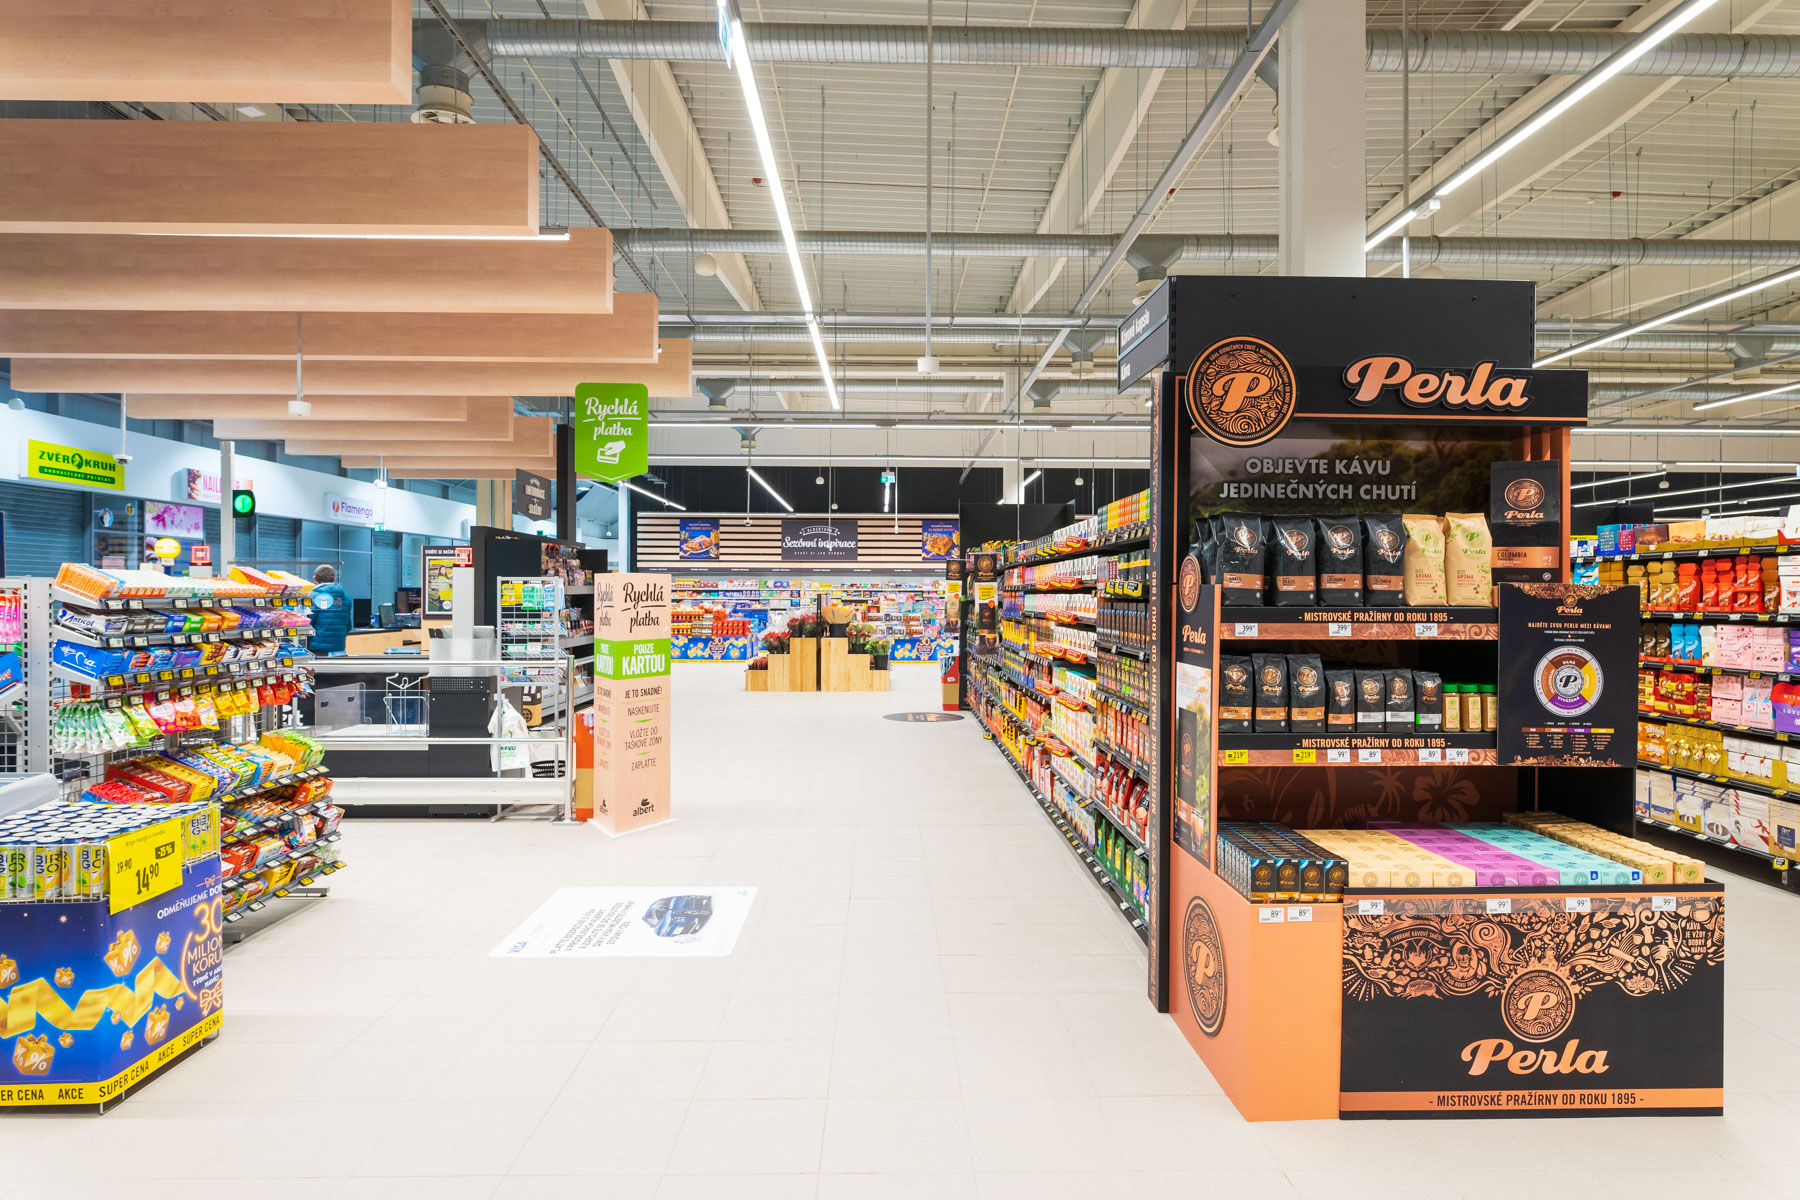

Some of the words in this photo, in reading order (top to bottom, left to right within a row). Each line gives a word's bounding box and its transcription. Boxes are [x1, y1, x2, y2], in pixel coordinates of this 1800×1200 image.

[1346, 356, 1529, 407] Perla
[1212, 372, 1271, 412] P
[585, 396, 639, 421] Rychlá
[593, 422, 632, 440] platba
[1245, 458, 1329, 474] OBJEVTE
[1335, 455, 1391, 475] KÁVU
[1219, 479, 1352, 499] JEDINEČNÝCH
[1360, 481, 1417, 500] CHUTÍ
[341, 501, 373, 519] Flamengo
[1504, 510, 1544, 519] Perla
[783, 536, 817, 548] Sezónní
[818, 538, 856, 548] inspirace
[623, 582, 664, 609] Rychlá
[64, 615, 95, 627] Anticol
[630, 611, 660, 633] platba
[1304, 611, 1351, 622] MISTROVSKÉ
[1354, 610, 1392, 622] PRAŽÍRNY
[1394, 613, 1405, 621] OD
[1406, 613, 1426, 621] ROKU
[1430, 613, 1448, 621] 1895
[1182, 624, 1206, 645] Perla
[634, 644, 654, 654] POUZE
[1152, 645, 1157, 661] OD
[622, 654, 665, 675] KARTOU
[1560, 675, 1577, 688] P
[625, 690, 630, 698] JE
[632, 689, 639, 697] TO
[640, 687, 662, 696] SNADNÉ!
[627, 704, 660, 716] NASKENUJTE
[629, 727, 649, 739] VLOŽTE
[650, 727, 658, 736] DO
[625, 738, 647, 750] TAŠKOVÉ
[649, 736, 662, 747] ZÓNY
[1302, 737, 1349, 748] MISTROVSKÉ
[1352, 737, 1389, 748] PRAŽÍRNY
[1392, 739, 1402, 748] OD
[1404, 739, 1424, 748] ROKU
[1427, 739, 1445, 748] 1895
[631, 758, 656, 771] ZAPLAŤTE
[632, 805, 654, 816] albert
[157, 890, 208, 919] ODMĚŇUJEME
[194, 896, 222, 942] 30
[1687, 920, 1700, 930] KÁVA
[1391, 931, 1410, 942] VYBRANÉ
[1192, 940, 1214, 985] P
[1518, 991, 1558, 1020] P
[183, 1026, 203, 1047] SUPER
[203, 1016, 219, 1035] CENA
[158, 1044, 175, 1063] AKCE
[1460, 1038, 1609, 1075] Perla
[99, 1074, 129, 1097] SUPER
[130, 1061, 149, 1080] CENA
[0, 1090, 13, 1101] ER
[18, 1089, 44, 1100] CENA
[58, 1088, 83, 1099] AKCE
[1436, 1092, 1502, 1106] MISTROVSKÉ
[1505, 1092, 1560, 1106] PRAŽÍRNY
[1562, 1094, 1576, 1105] OD
[1579, 1094, 1608, 1105] ROKU
[1611, 1093, 1636, 1105] 1895
